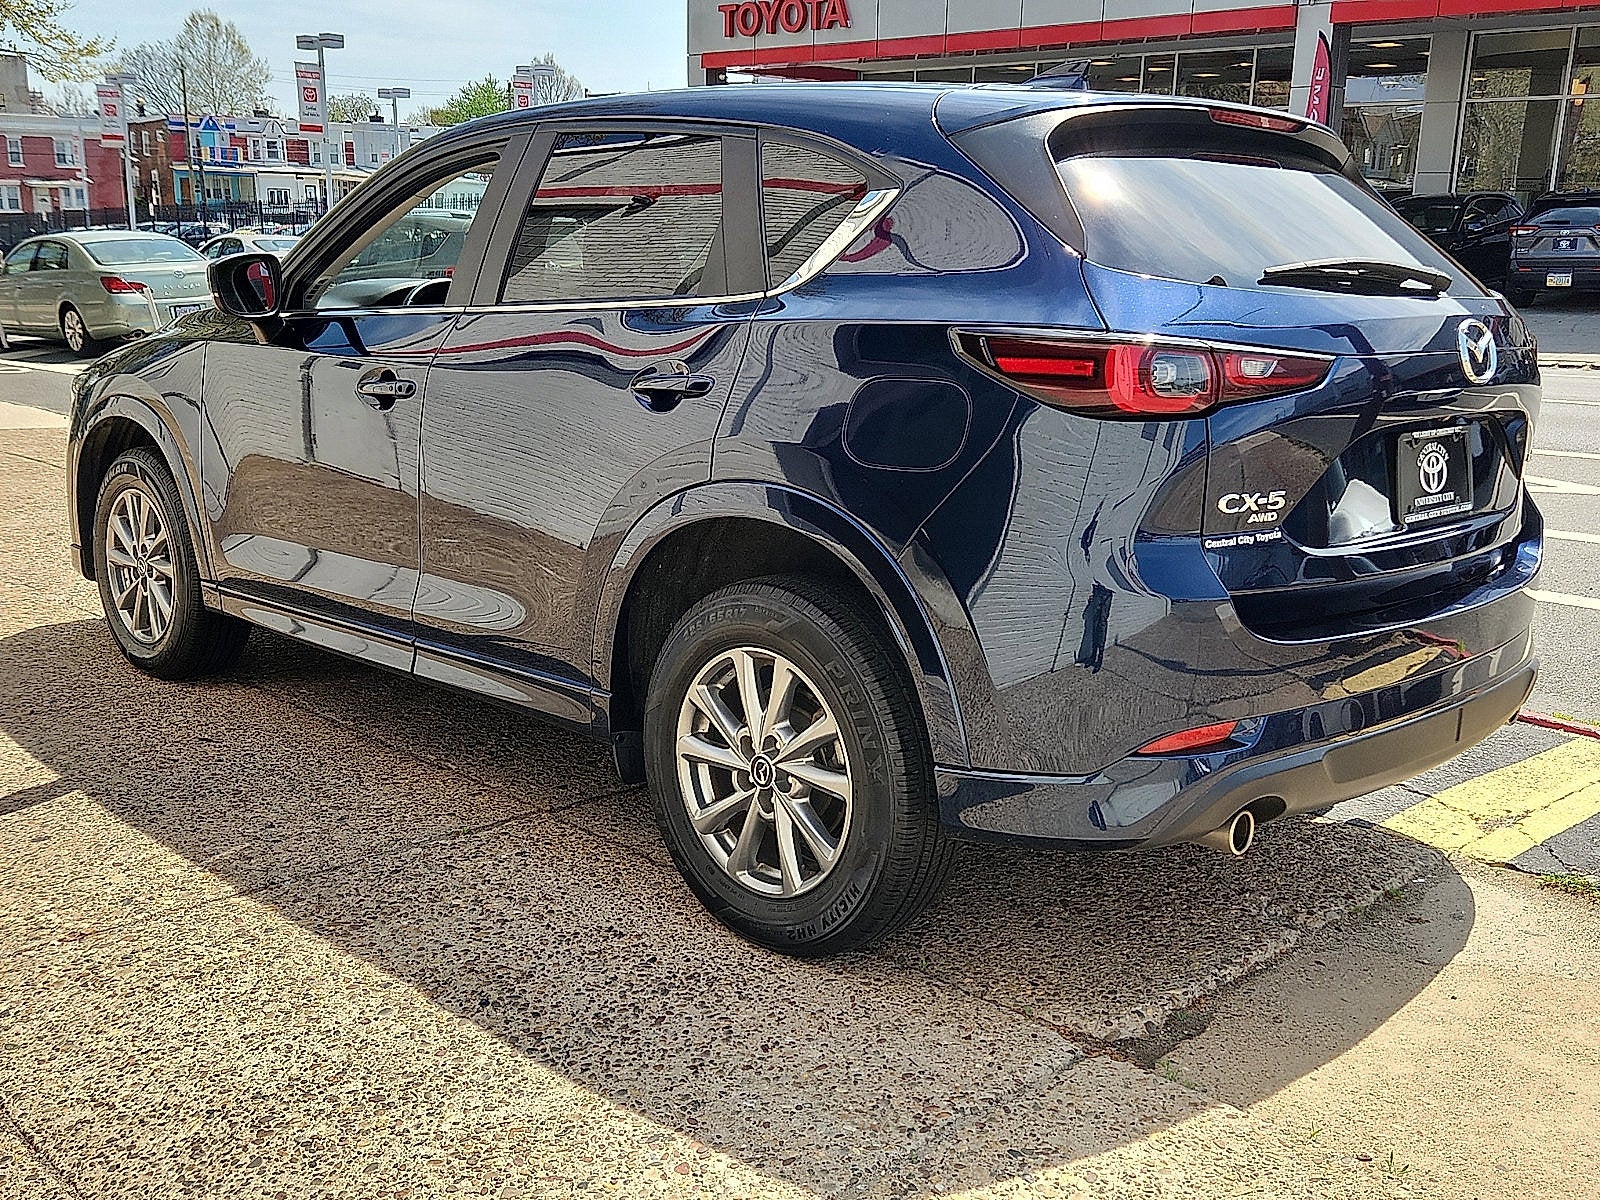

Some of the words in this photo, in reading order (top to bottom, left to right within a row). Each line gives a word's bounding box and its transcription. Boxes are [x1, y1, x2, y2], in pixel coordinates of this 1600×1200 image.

[718, 0, 850, 38] TOYOTA
[1217, 490, 1287, 514] CX-5
[1246, 511, 1278, 524] AWD
[1204, 537, 1237, 549] Central
[1237, 536, 1255, 545] City
[1255, 527, 1282, 542] Toyota
